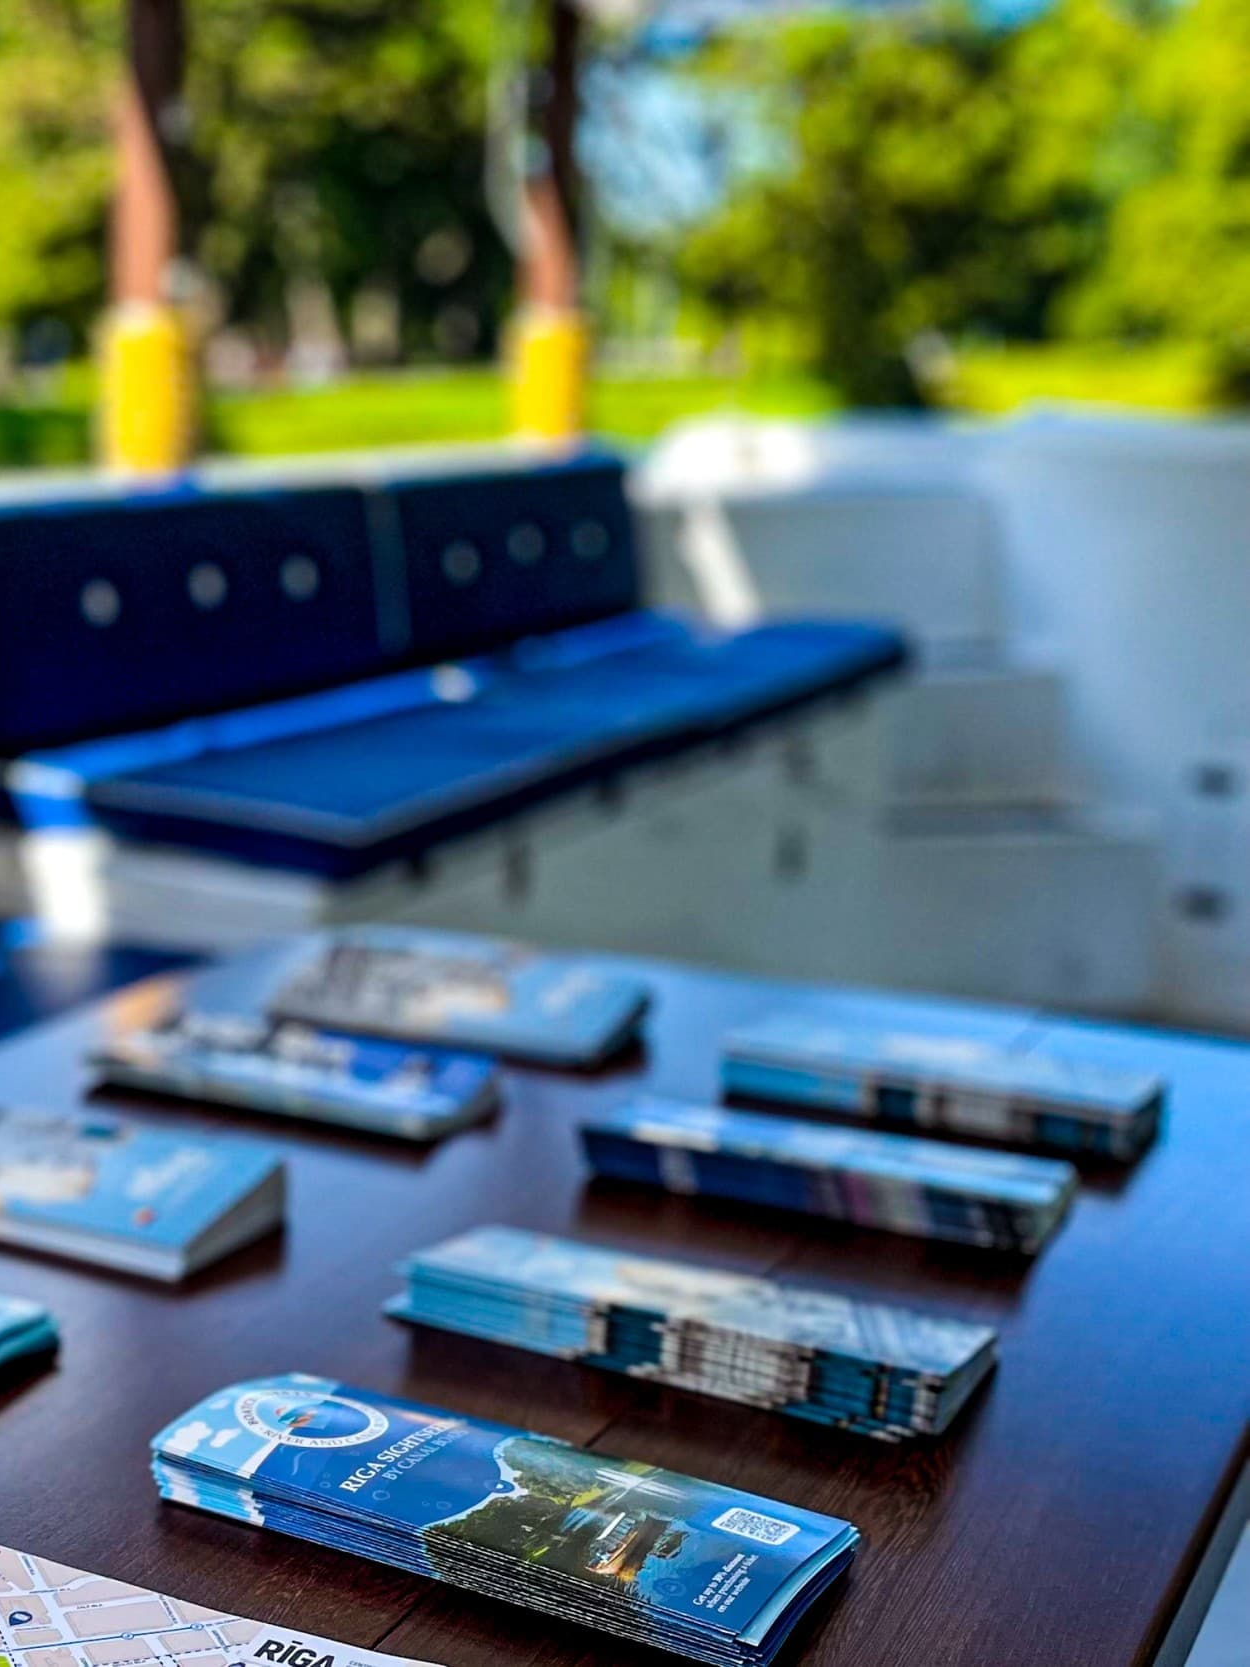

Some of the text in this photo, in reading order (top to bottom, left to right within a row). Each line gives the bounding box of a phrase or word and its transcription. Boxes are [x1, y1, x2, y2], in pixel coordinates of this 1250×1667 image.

[339, 1418, 463, 1493] RIGA SIGHTSEE
[382, 1466, 404, 1481] BY
[397, 1443, 441, 1469] CANAL
[692, 1594, 708, 1605] Get
[253, 1640, 336, 1667] RĪGA
